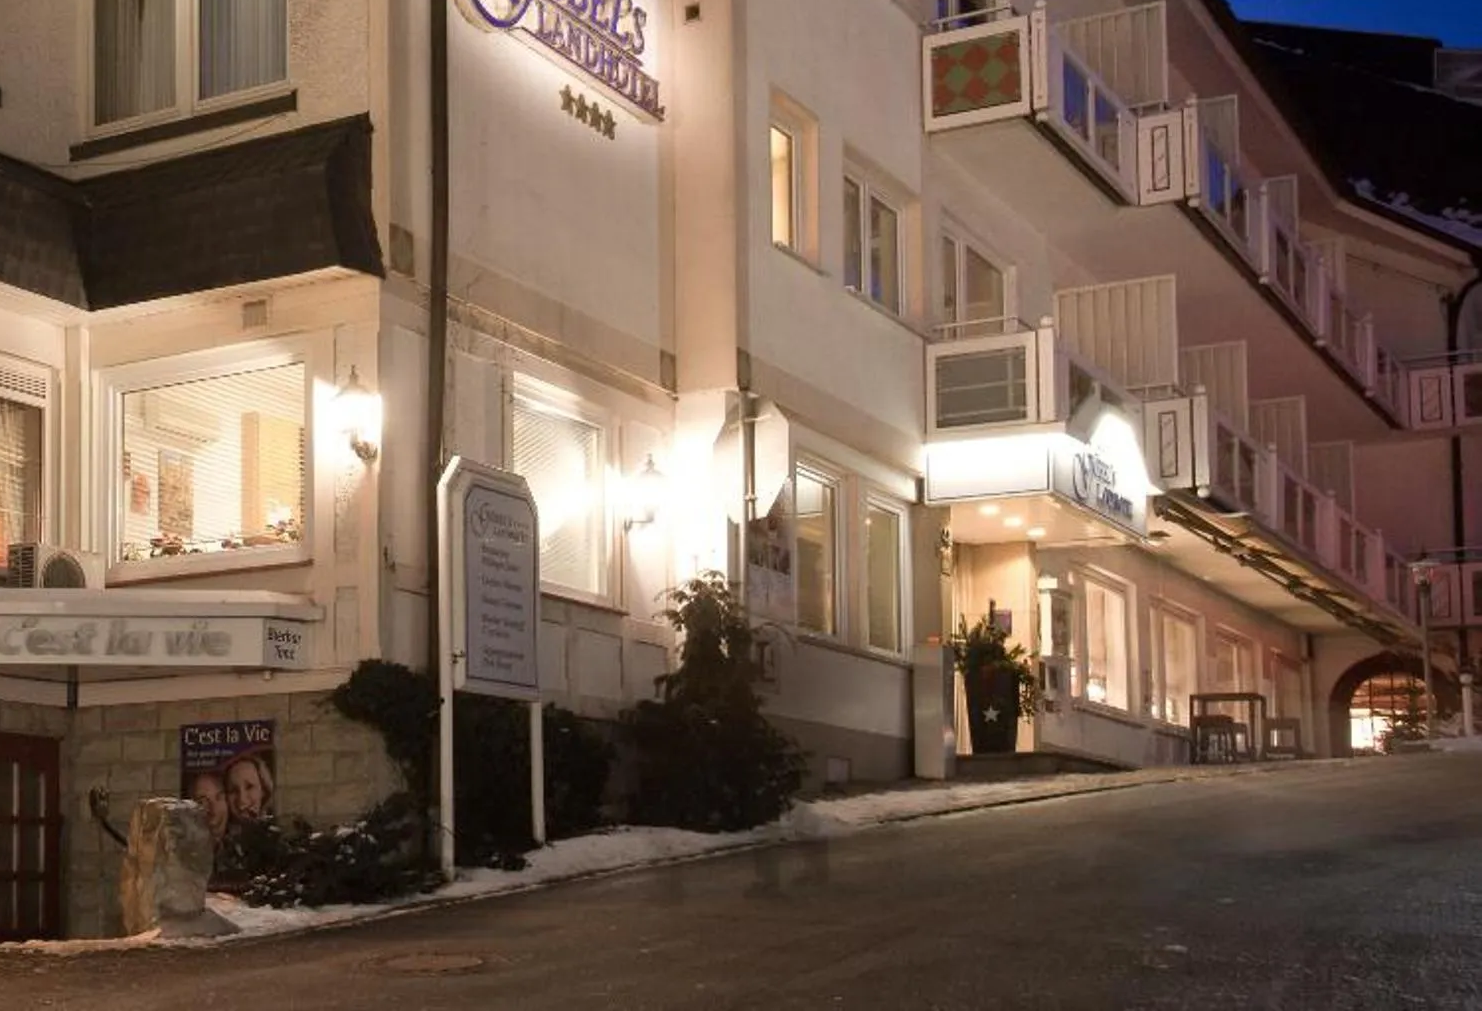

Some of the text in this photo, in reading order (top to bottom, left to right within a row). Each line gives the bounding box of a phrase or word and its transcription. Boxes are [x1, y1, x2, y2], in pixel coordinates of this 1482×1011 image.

[105, 617, 154, 656] la
[184, 723, 270, 746] C'est la Vie
